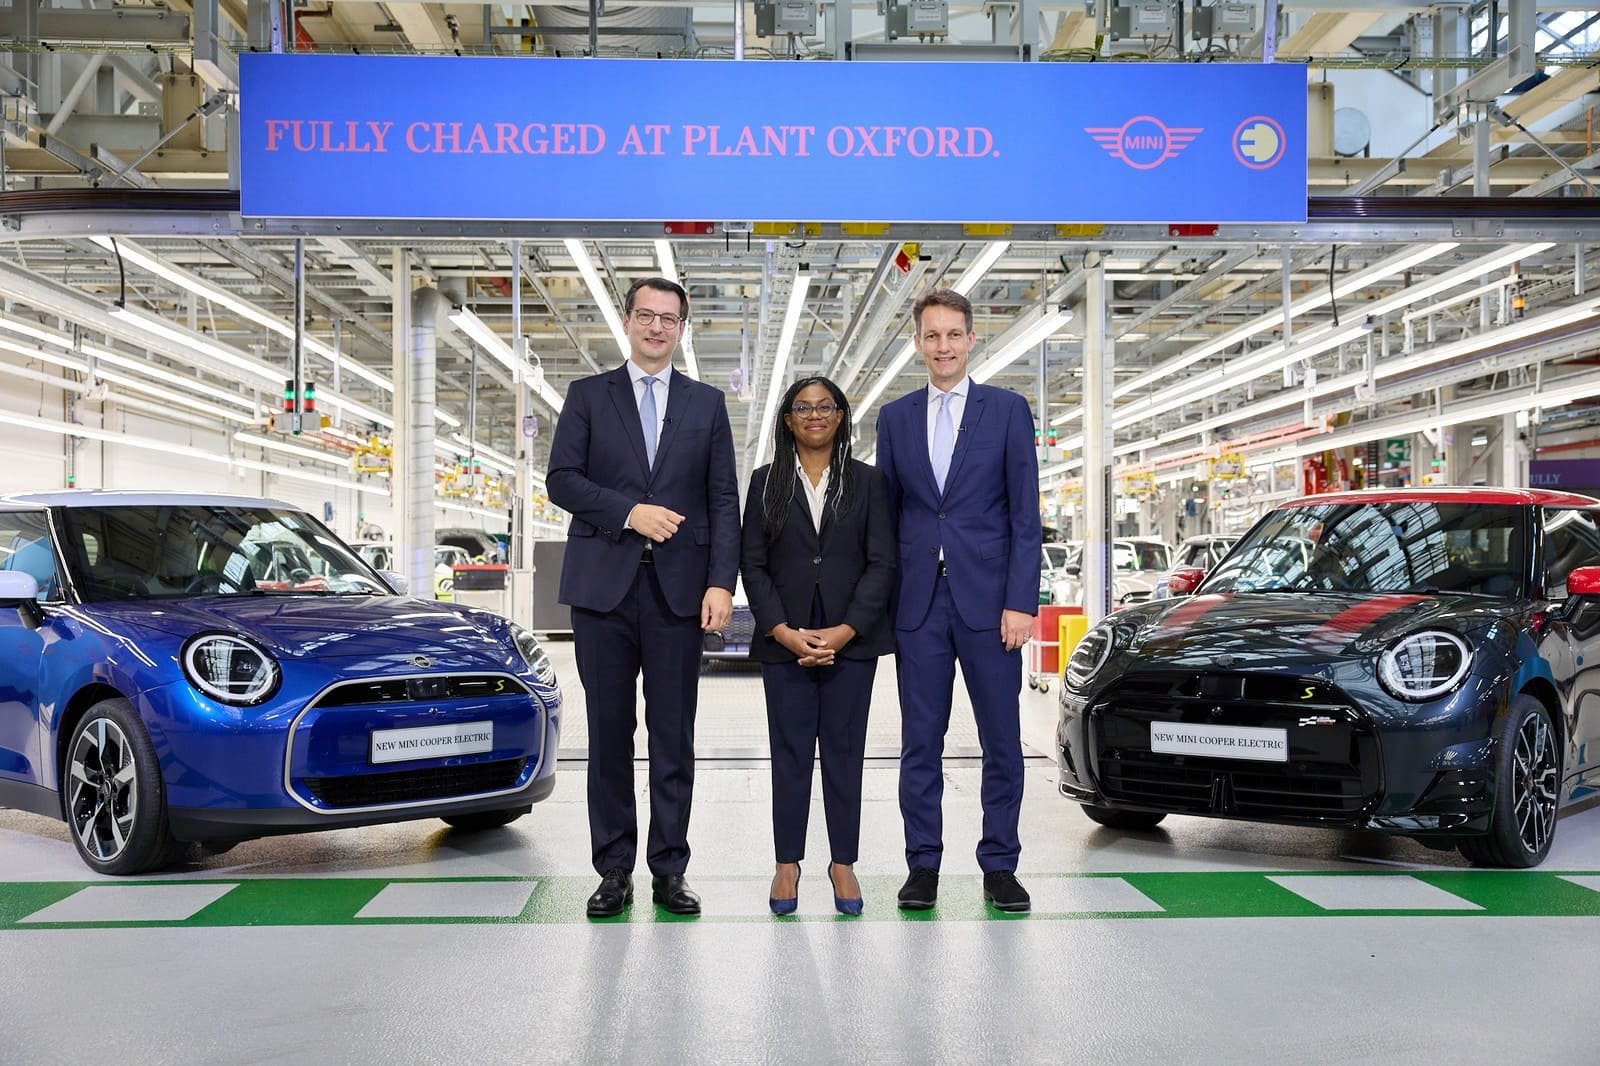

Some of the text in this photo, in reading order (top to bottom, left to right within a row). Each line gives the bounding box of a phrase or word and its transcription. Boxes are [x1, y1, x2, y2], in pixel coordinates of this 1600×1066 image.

[265, 119, 1002, 158] FULLY CHARGED AT PLANT OXFORD.
[1124, 135, 1164, 150] MINI
[375, 732, 491, 752] NEW MINI COOPER ELECTRIC
[1154, 732, 1284, 749] NEW MINI COOPER ELECTRIC
